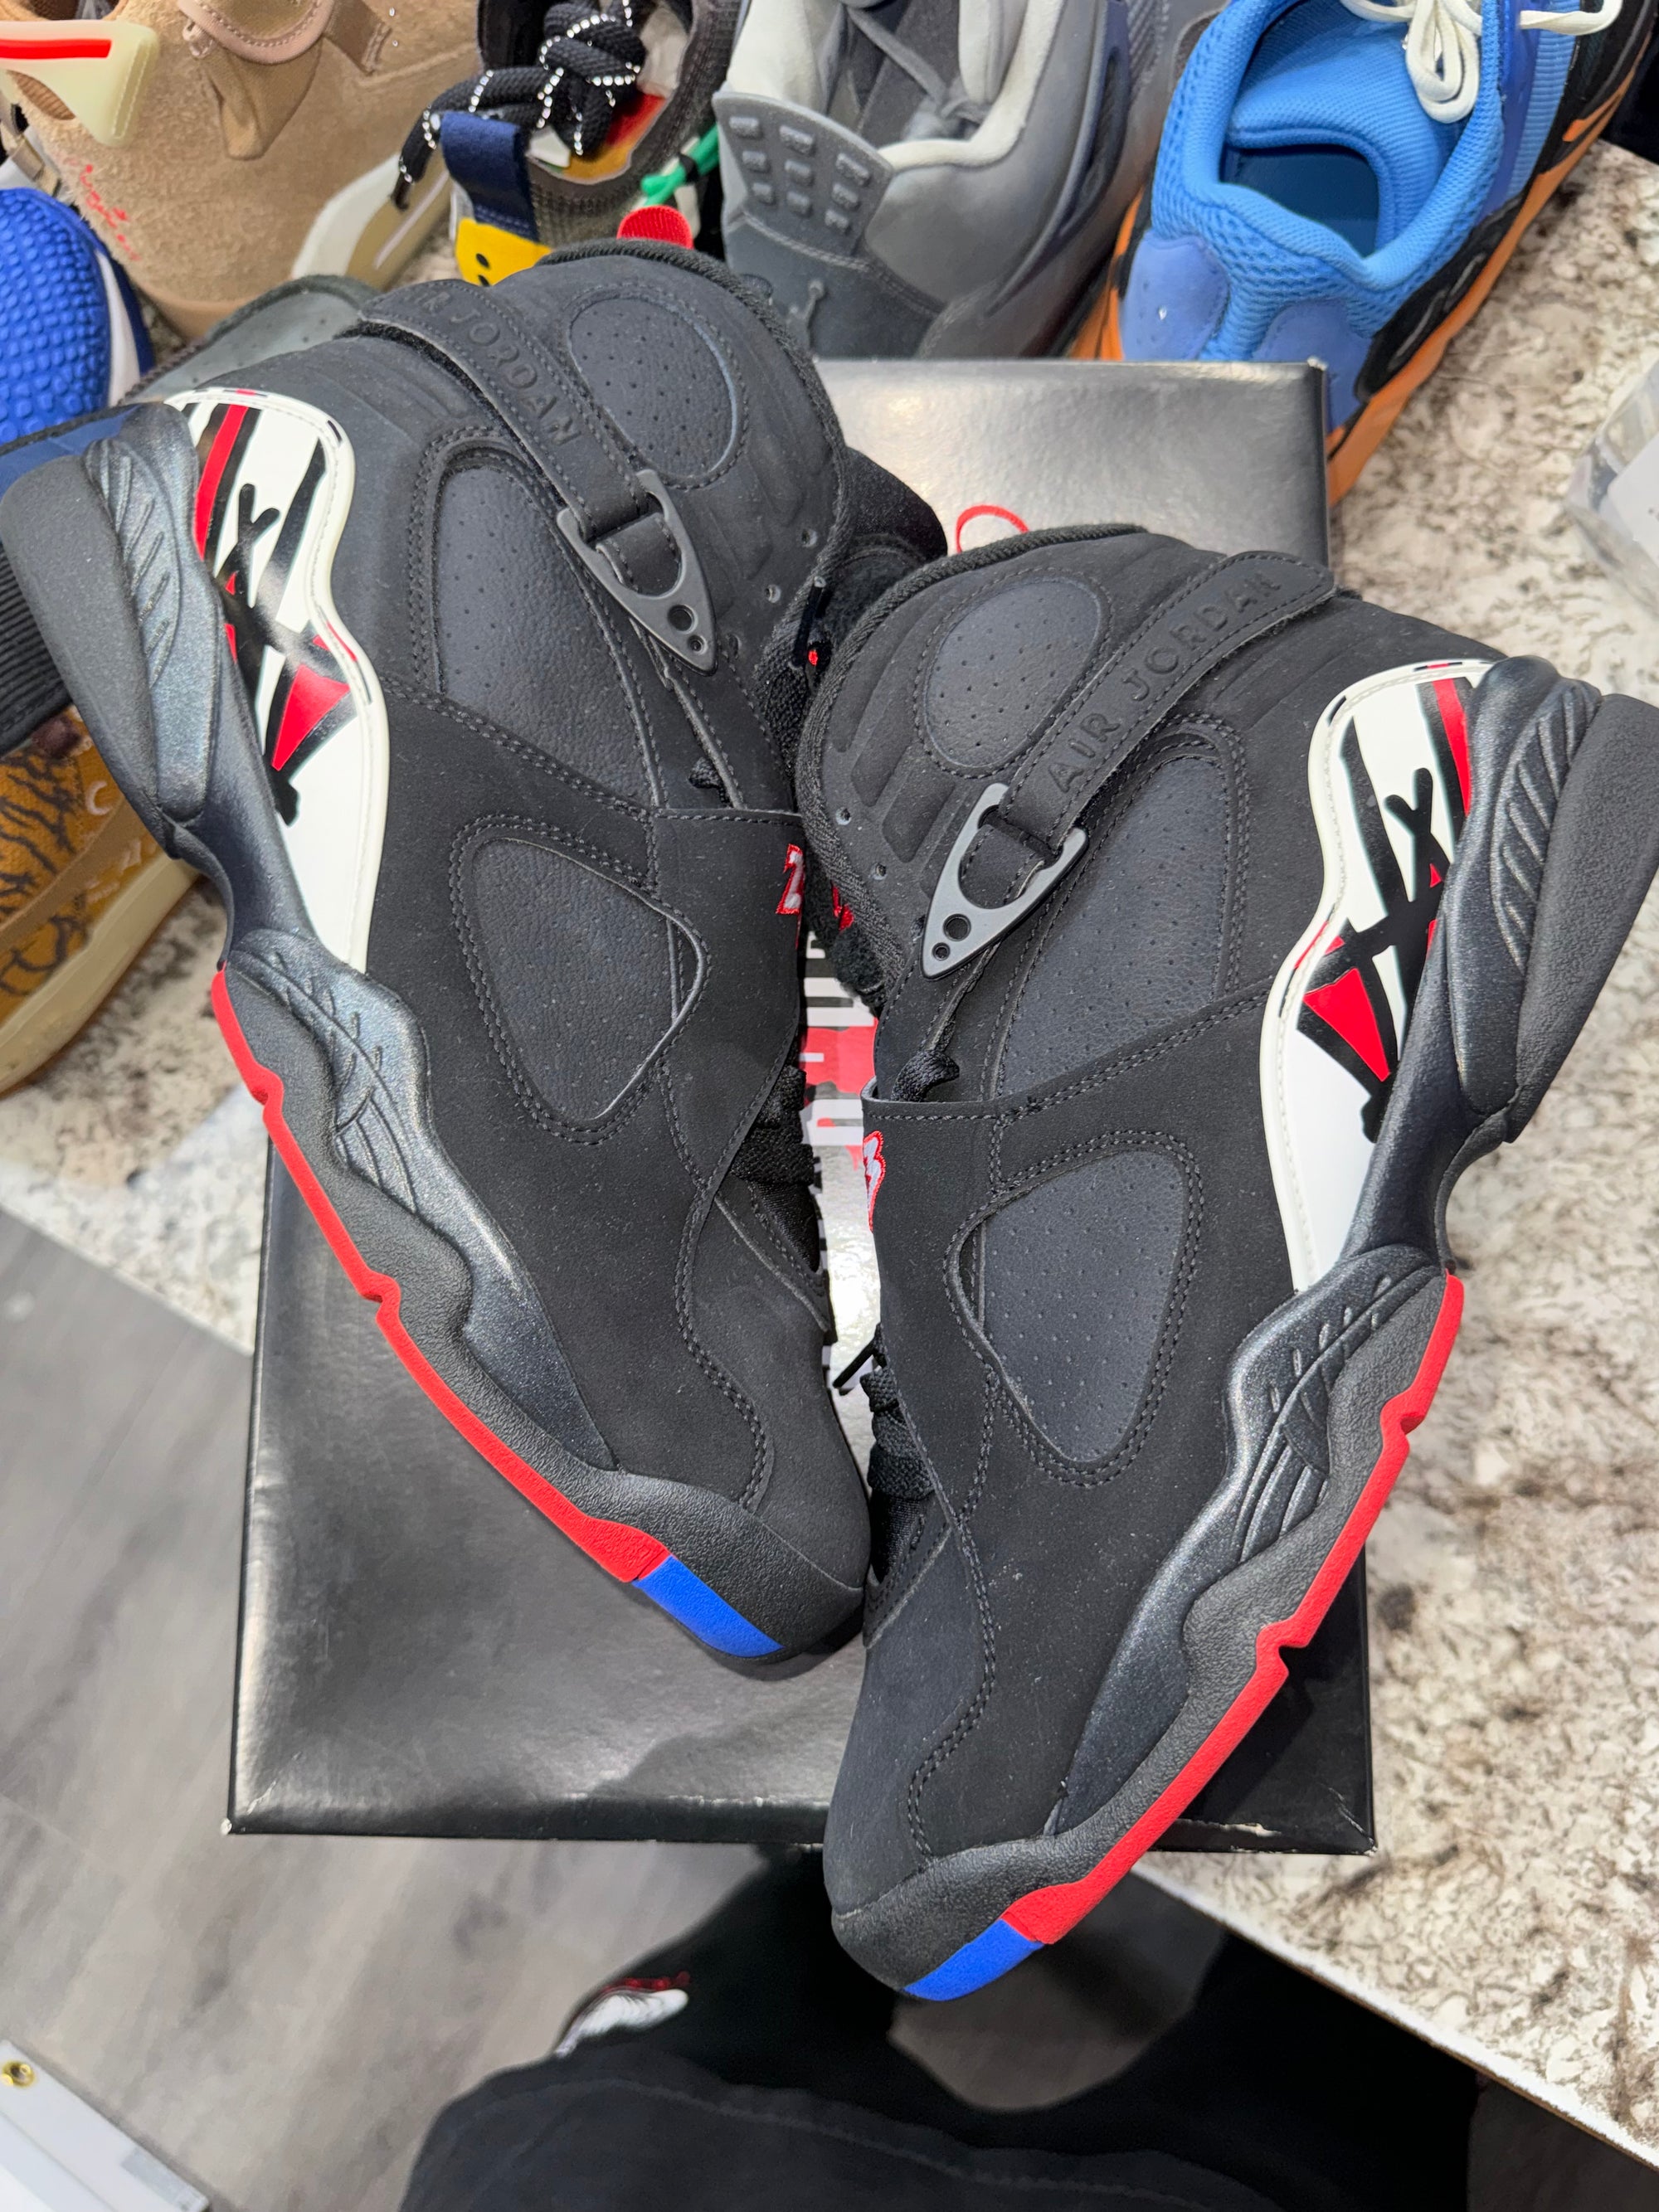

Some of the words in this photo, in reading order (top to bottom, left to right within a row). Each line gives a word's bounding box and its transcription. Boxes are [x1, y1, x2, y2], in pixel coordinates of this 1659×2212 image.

[450, 308, 582, 447] JORDAN
[1047, 712, 1122, 794] AIR
[1120, 572, 1282, 702] JORDAN
